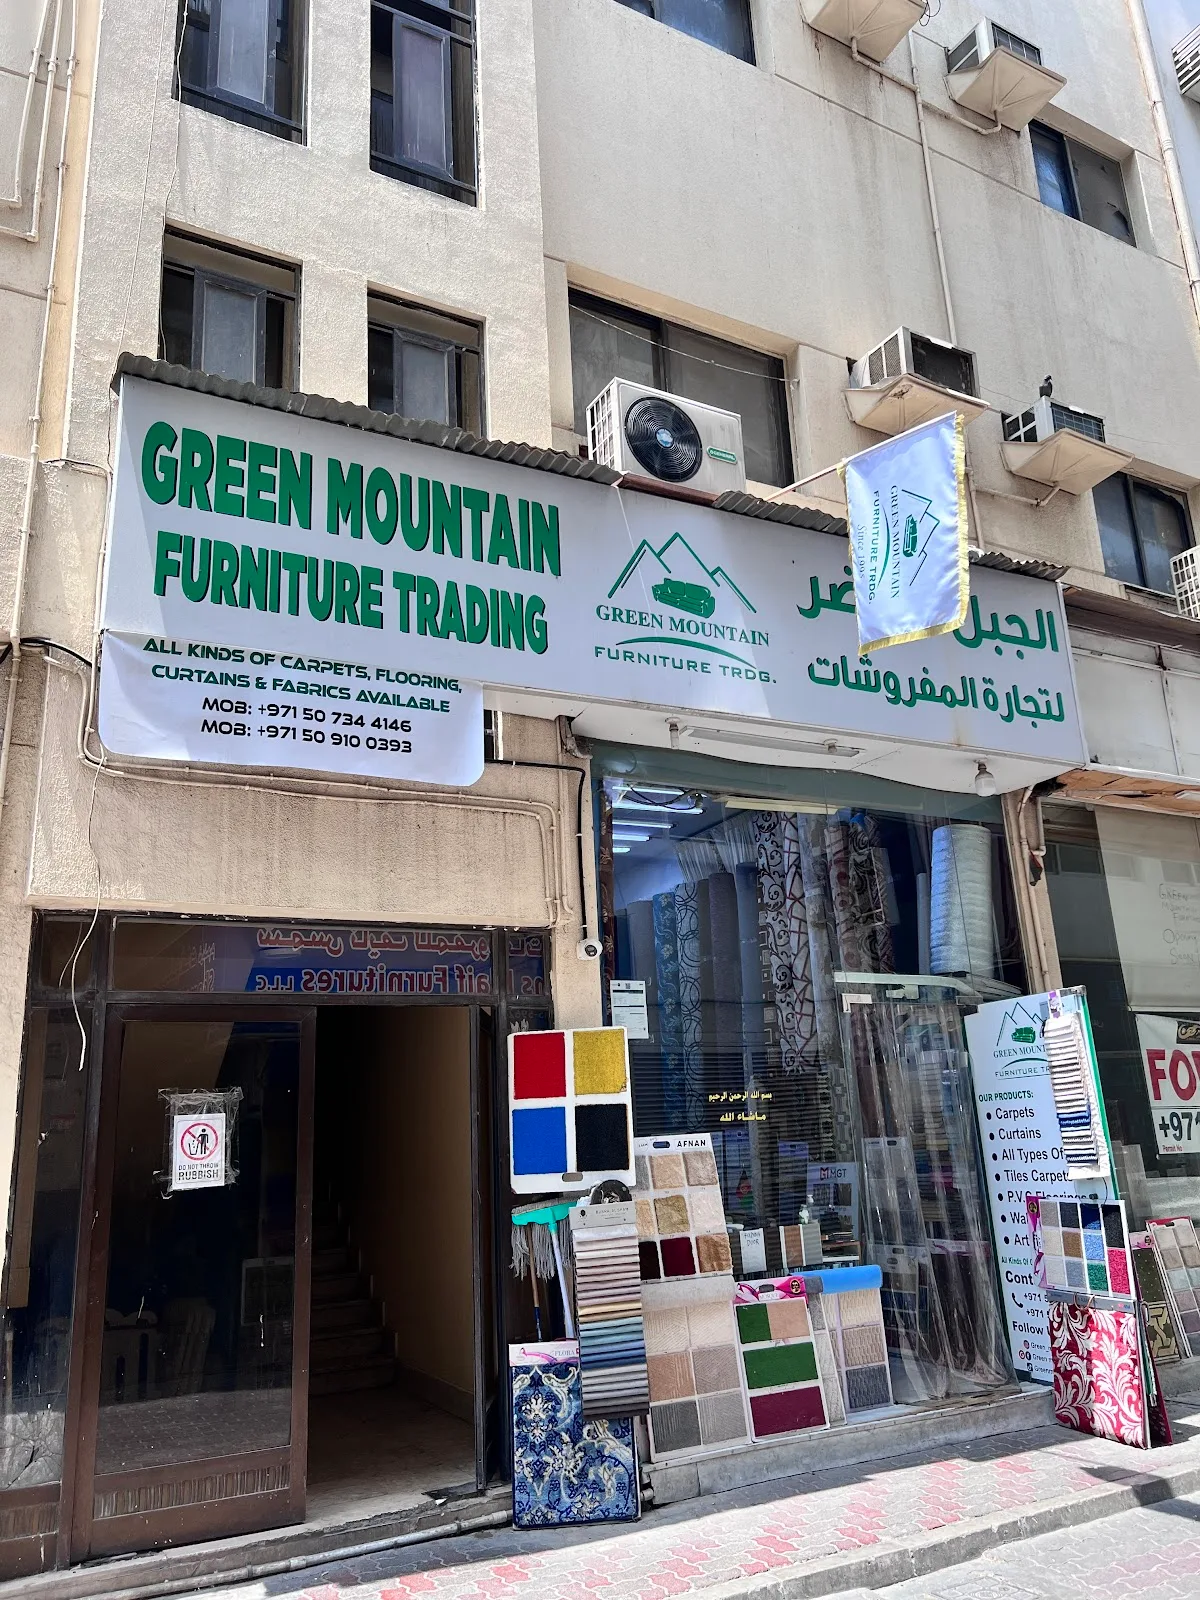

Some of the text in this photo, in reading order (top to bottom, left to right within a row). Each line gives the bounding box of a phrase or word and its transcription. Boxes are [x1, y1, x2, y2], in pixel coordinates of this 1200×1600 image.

[141, 421, 562, 577] GREEN MOUNTAIN
[857, 524, 868, 551] Since
[868, 490, 880, 605] FURNITURE TRDG.
[890, 484, 901, 599] GREEN MOUNTAIN
[153, 530, 548, 655] FURNITURE TRADING
[596, 604, 770, 647] GREEN MOUNTAIN
[953, 595, 1060, 660] الجبل
[143, 637, 463, 694] ALL KINDS OF CARPETS, FLOORING,
[594, 645, 777, 684] FURNITURE TRDG.
[151, 664, 451, 713] CURTAINS & FABRICS AVAILABLE
[807, 653, 1065, 728] لتجارة المفروشات
[202, 697, 412, 733] MOB: +971 50 734 4146
[201, 719, 412, 754] MOB: +971 50 910 0393
[993, 1044, 1047, 1059] GREEN MOUNT
[995, 1066, 1051, 1078] FURNITURE TR
[1146, 1049, 1200, 1101] FO
[708, 1090, 773, 1102] بسم الله الرحمن الرحيم
[978, 1090, 1034, 1102] OUR PRODUCTS:
[720, 1112, 735, 1122] الله
[995, 1106, 1035, 1121] Carpets
[998, 1127, 1042, 1140] Curtains
[1158, 1111, 1200, 1142] +97
[676, 1139, 706, 1148] AFNAN
[1002, 1147, 1064, 1163] All Types Of
[178, 1169, 219, 1181] RUBBISH
[1004, 1170, 1028, 1181] Tiles
[1005, 1270, 1034, 1286] Cont
[1024, 1293, 1042, 1302] +971
[1026, 1308, 1044, 1318] +971
[1012, 1320, 1044, 1336] Follow
